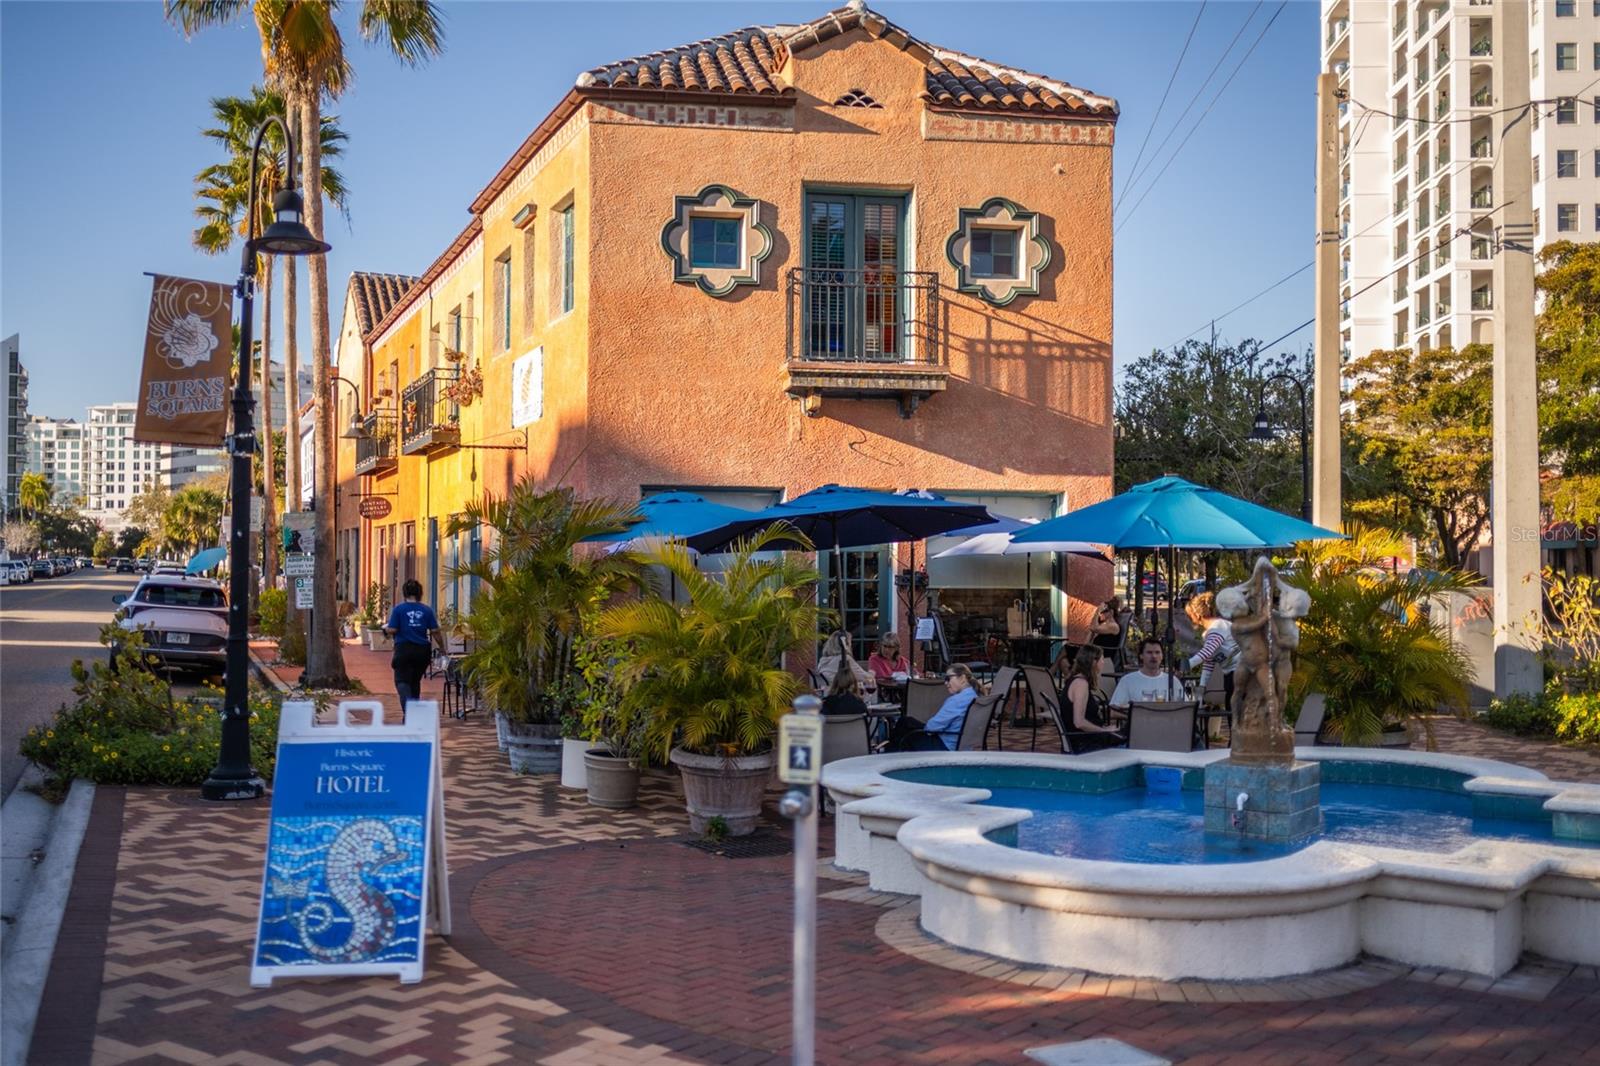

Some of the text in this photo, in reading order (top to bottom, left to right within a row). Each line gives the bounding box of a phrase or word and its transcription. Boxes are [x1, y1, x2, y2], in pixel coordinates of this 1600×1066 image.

[146, 377, 224, 400] BURNS
[146, 396, 224, 420] SQUARE
[335, 749, 374, 757] Historic
[320, 763, 387, 773] Burns Square
[316, 775, 391, 794] HOTEL
